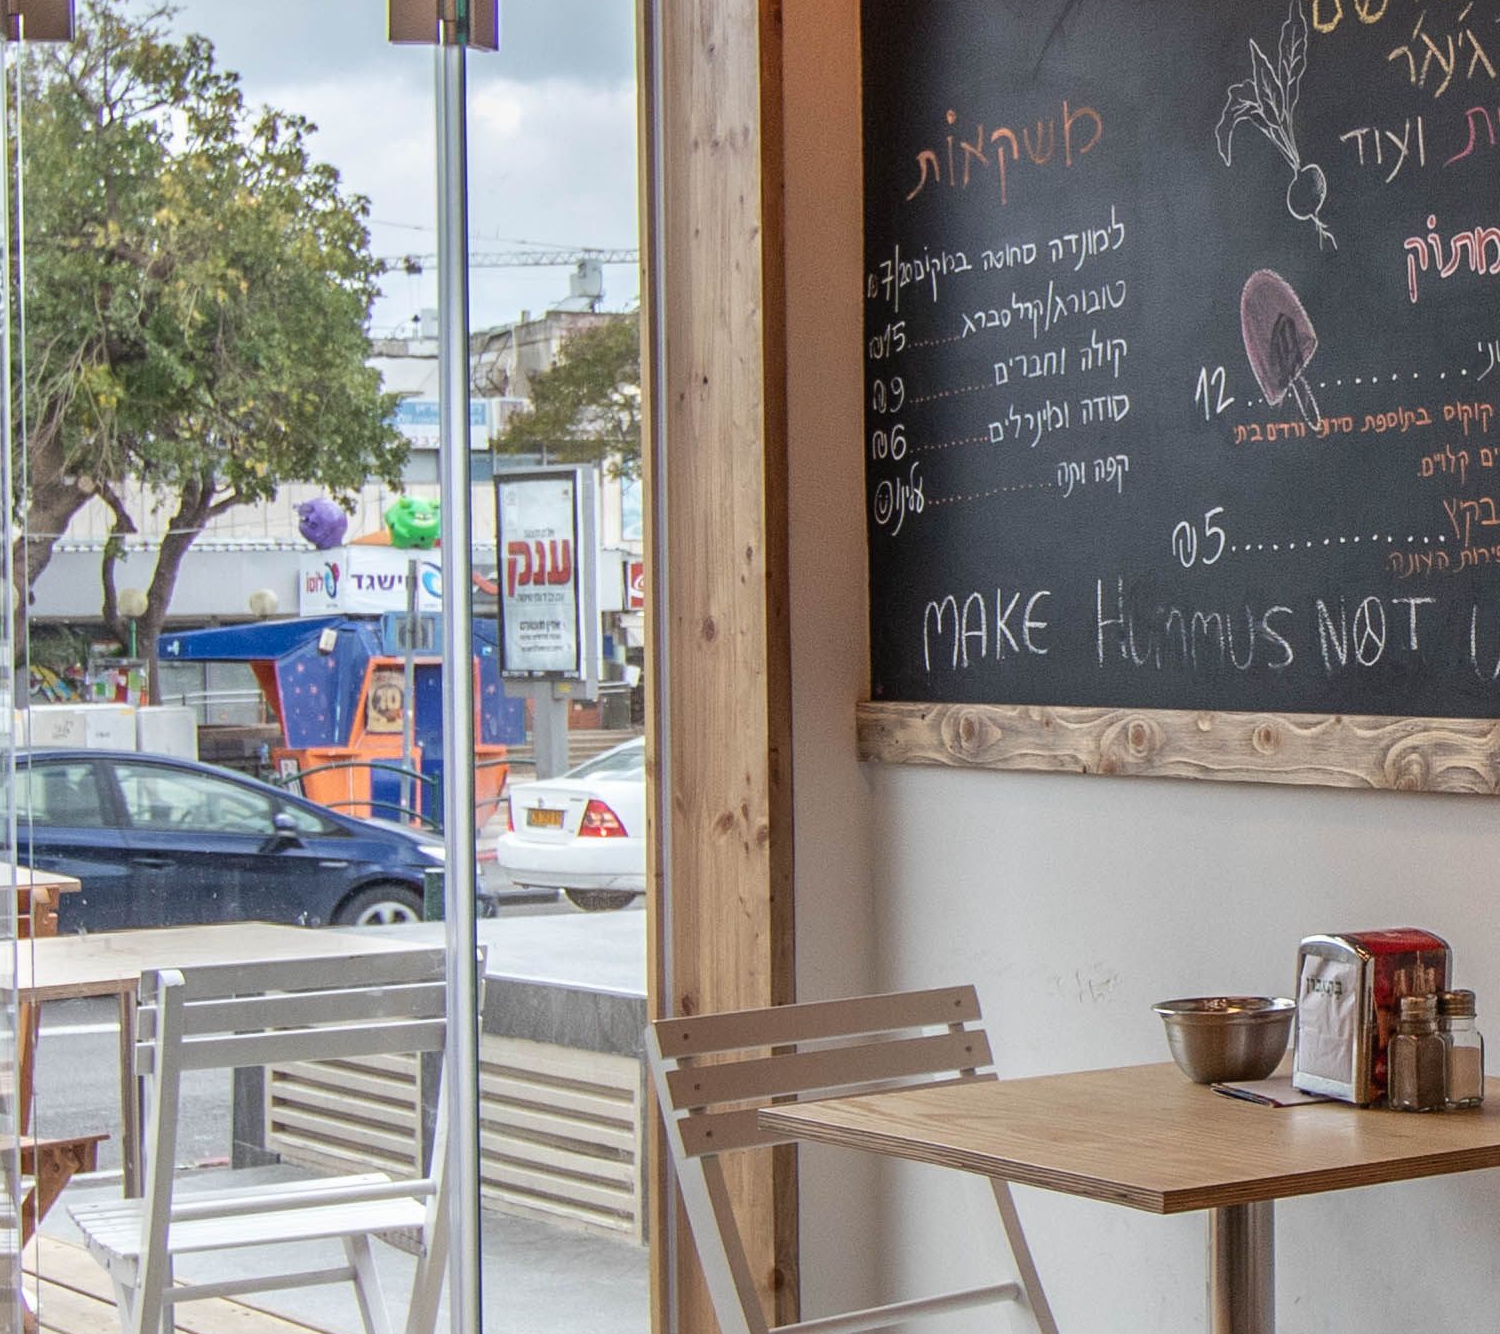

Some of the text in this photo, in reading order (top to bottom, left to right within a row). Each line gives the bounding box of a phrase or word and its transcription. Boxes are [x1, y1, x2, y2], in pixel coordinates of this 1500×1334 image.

[1339, 116, 1426, 183] ועוד
[981, 205, 1125, 271] לימונדה סחוטה
[993, 329, 1128, 386] קולה וחברים
[988, 393, 1130, 448] סודה ומינרלים
[1194, 365, 1235, 420] 12
[1056, 453, 1129, 498] קפה ותה
[507, 538, 572, 598] ענק
[924, 587, 1052, 669] MAKE
